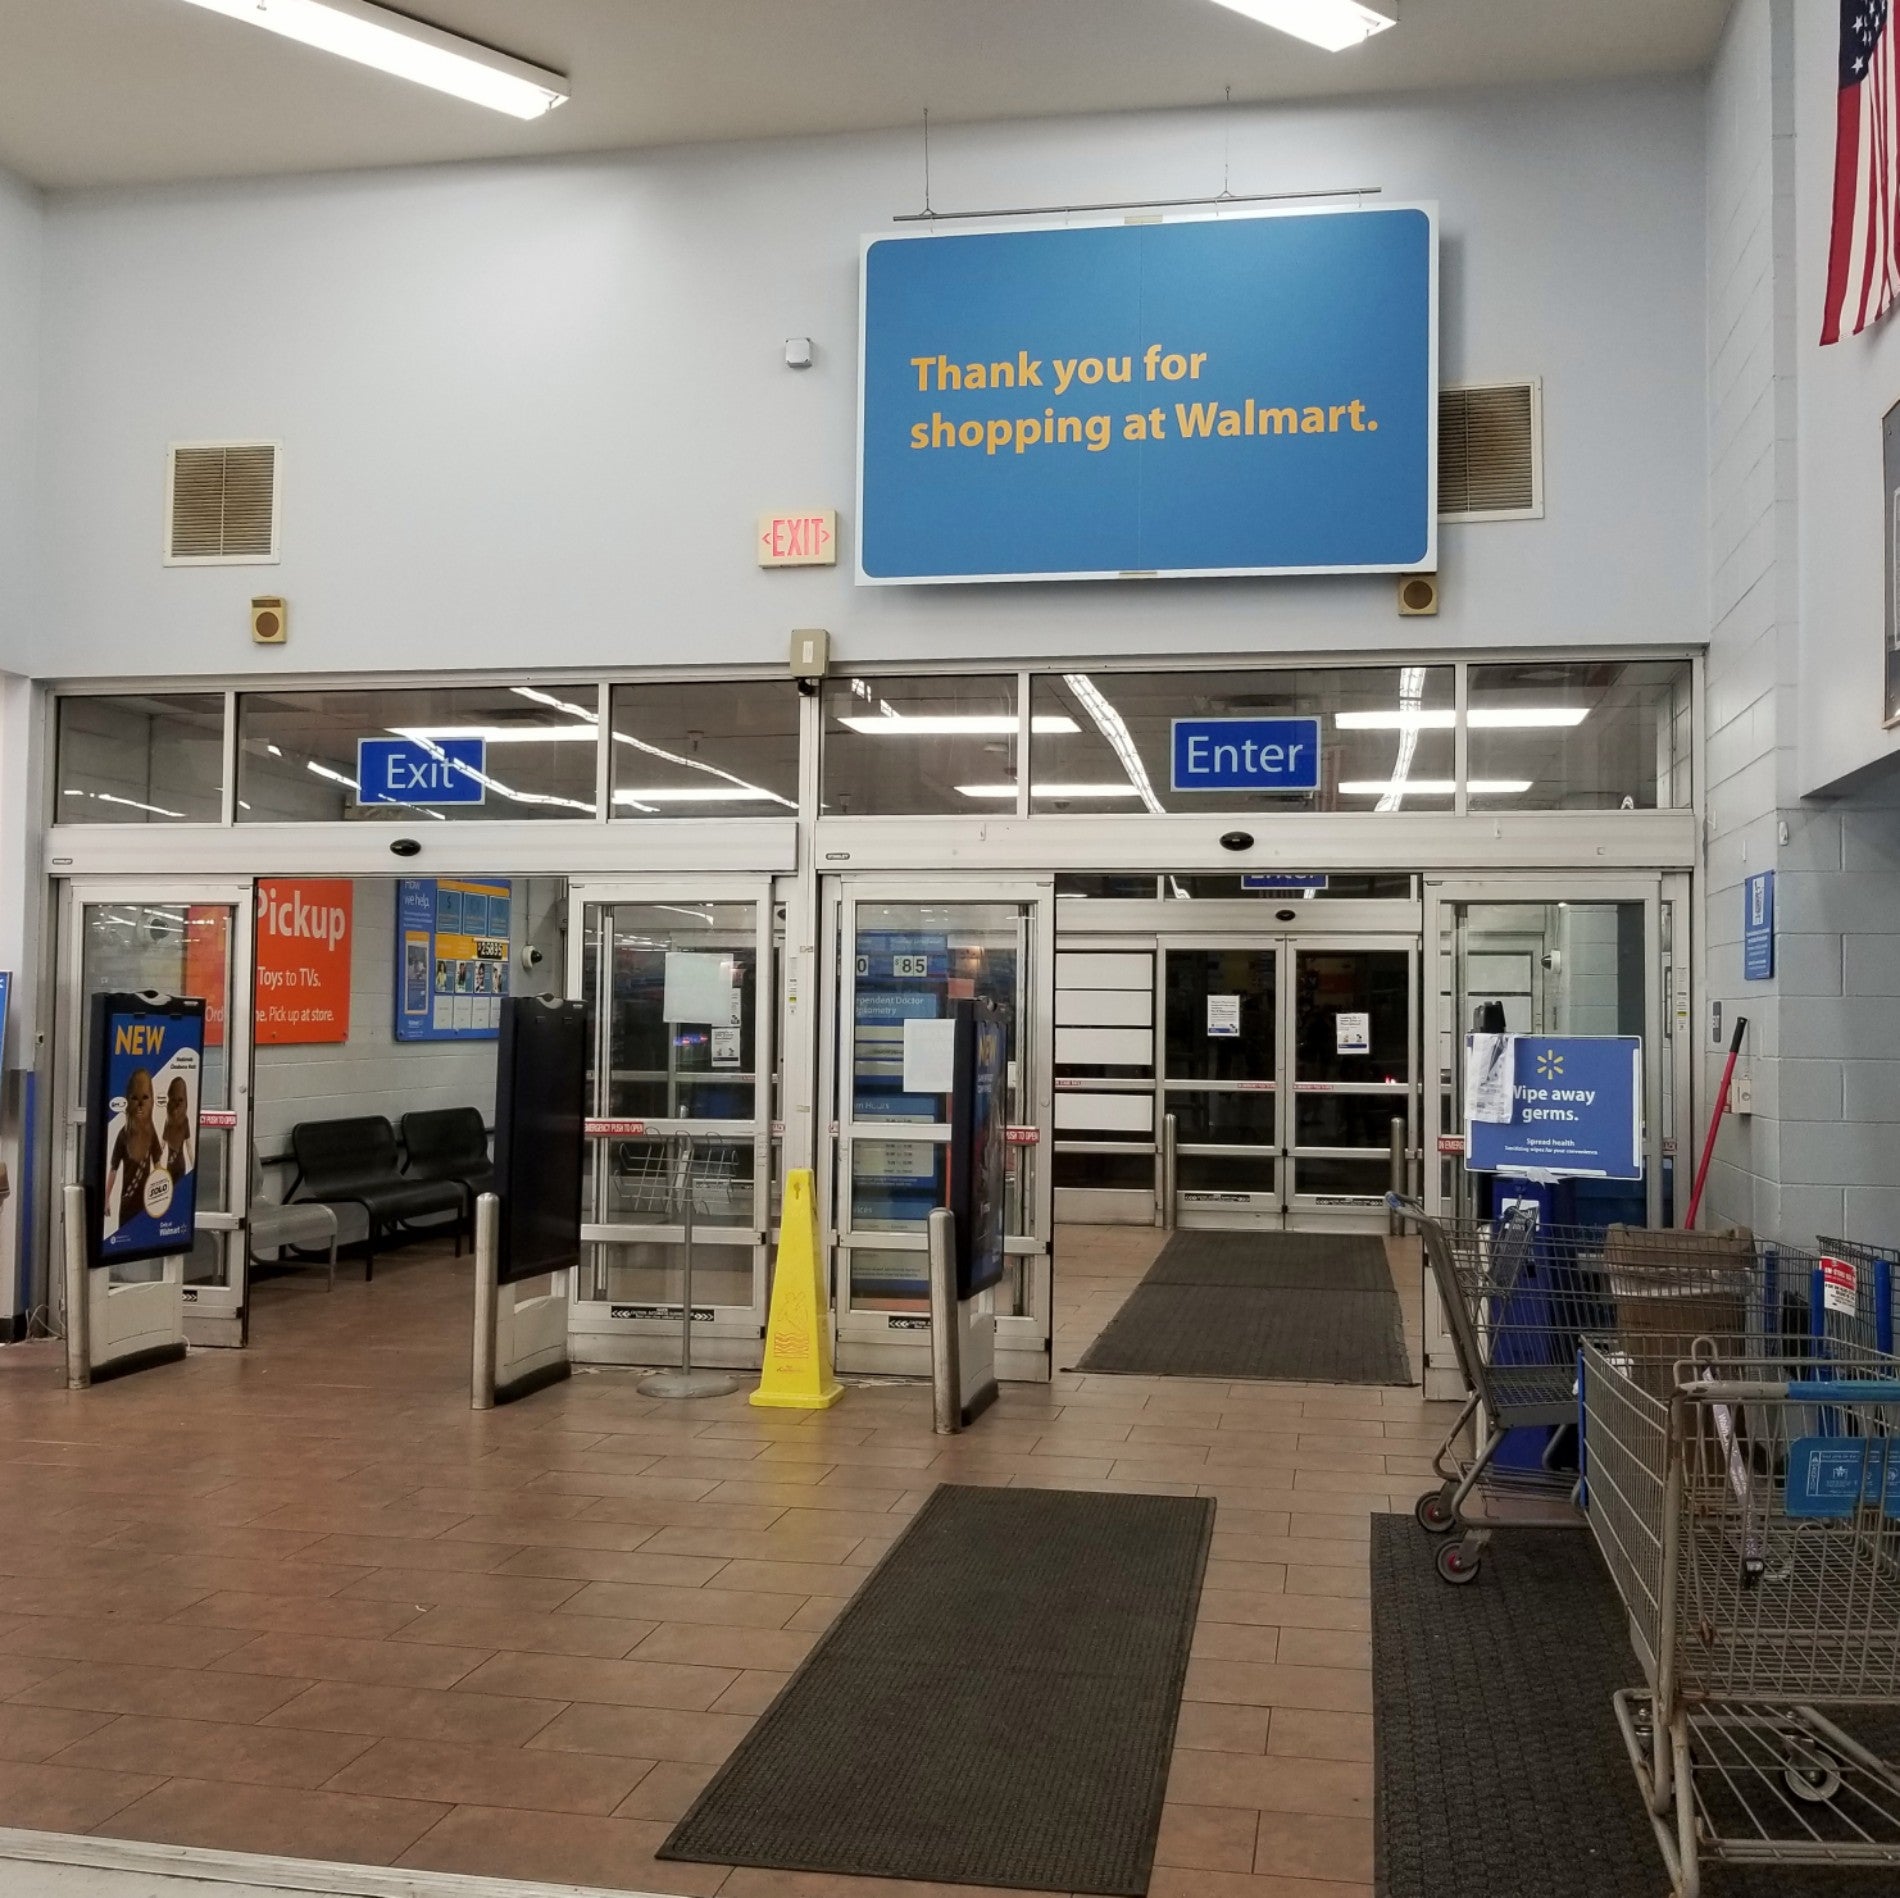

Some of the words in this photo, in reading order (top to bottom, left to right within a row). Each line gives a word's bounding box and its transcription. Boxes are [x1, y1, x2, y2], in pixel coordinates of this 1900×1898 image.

[910, 350, 1043, 392] Thank
[1052, 355, 1132, 395] you
[1143, 344, 1207, 382] for
[910, 408, 1111, 455] shopping
[1123, 407, 1166, 440] at
[1175, 399, 1378, 438] Walmart.
[772, 518, 824, 557] EXIT
[1188, 736, 1303, 773] Enter
[387, 754, 454, 789] Exit
[257, 966, 283, 990] Toys
[286, 970, 297, 987] to
[299, 968, 321, 987] TVs.
[895, 996, 924, 1005] Doctor
[205, 1006, 224, 1023] Ord
[269, 1006, 287, 1023] Pick
[288, 1009, 300, 1025] up
[301, 1008, 310, 1022] at
[114, 1025, 165, 1055] NEW
[1551, 1089, 1595, 1106] away
[1522, 1108, 1579, 1123] germs.
[1445, 1140, 1464, 1150] EMERG
[1526, 1138, 1551, 1146] Spread
[1552, 1138, 1575, 1147] health
[150, 1184, 167, 1197] SOLO
